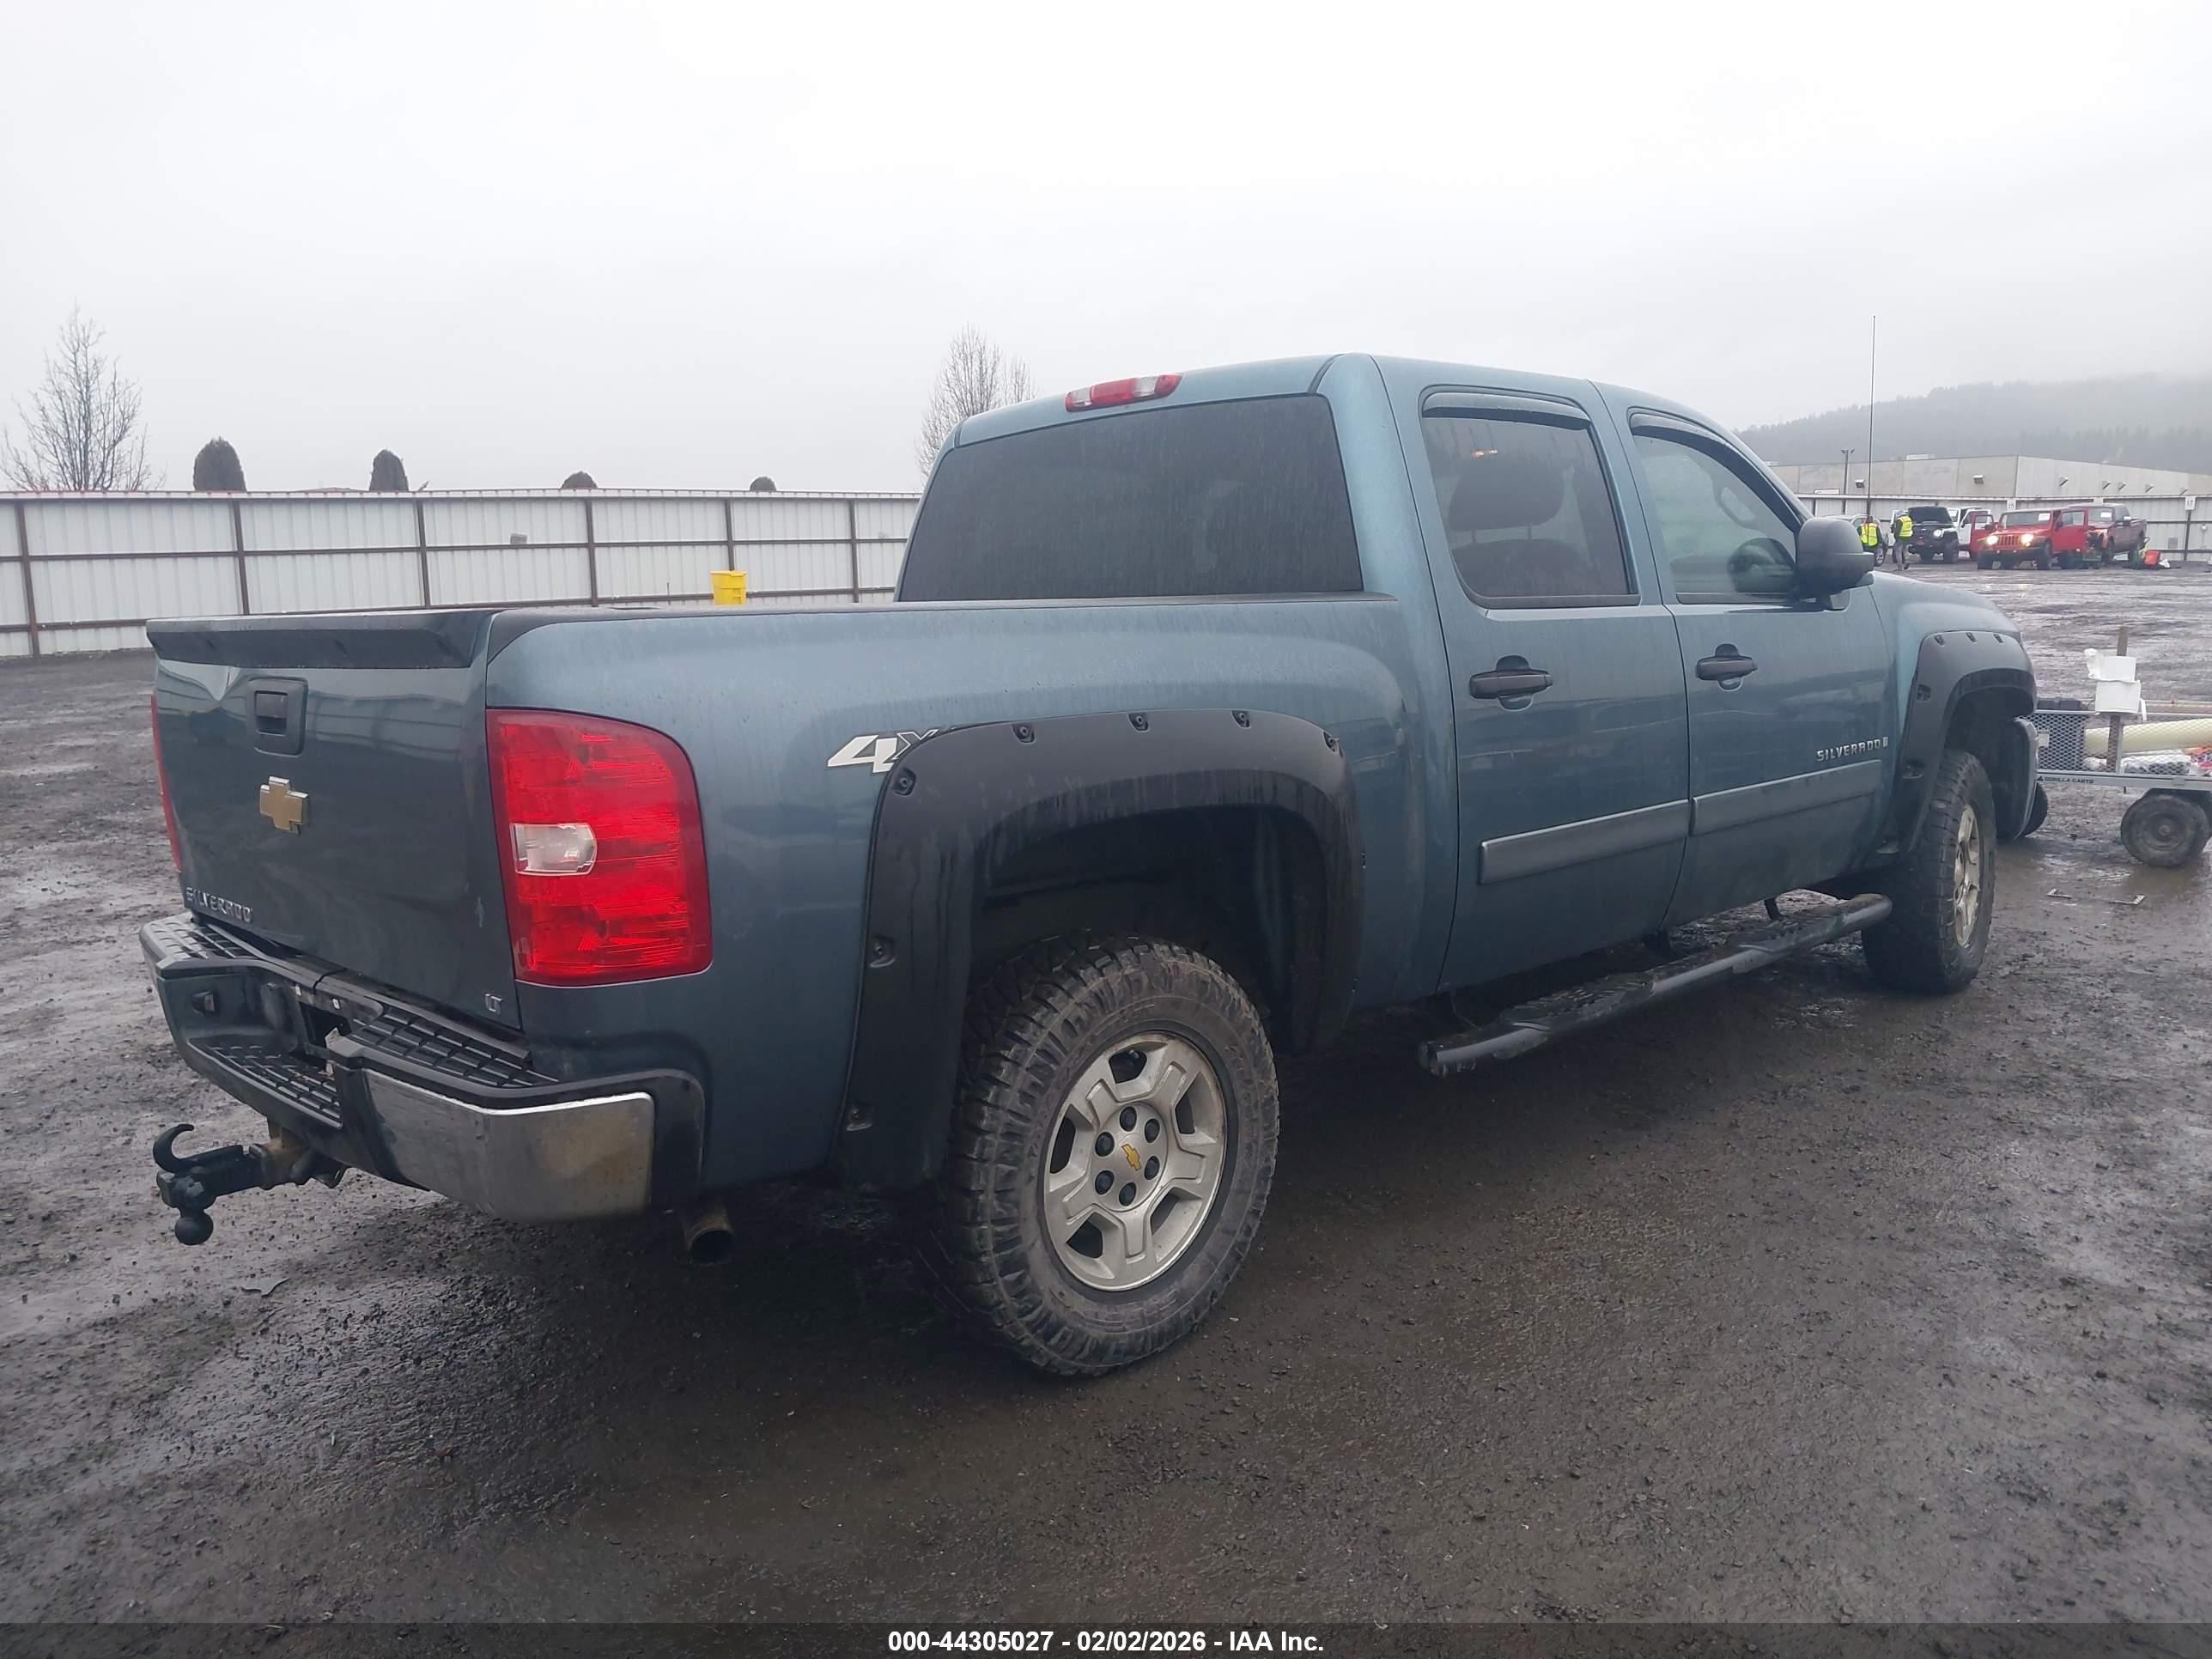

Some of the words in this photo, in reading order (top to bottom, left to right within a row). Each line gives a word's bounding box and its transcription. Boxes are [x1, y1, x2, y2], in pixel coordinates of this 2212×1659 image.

[1816, 738, 1881, 762] SILVERADO
[185, 886, 252, 922] SILVERADO
[485, 994, 501, 1014] LT
